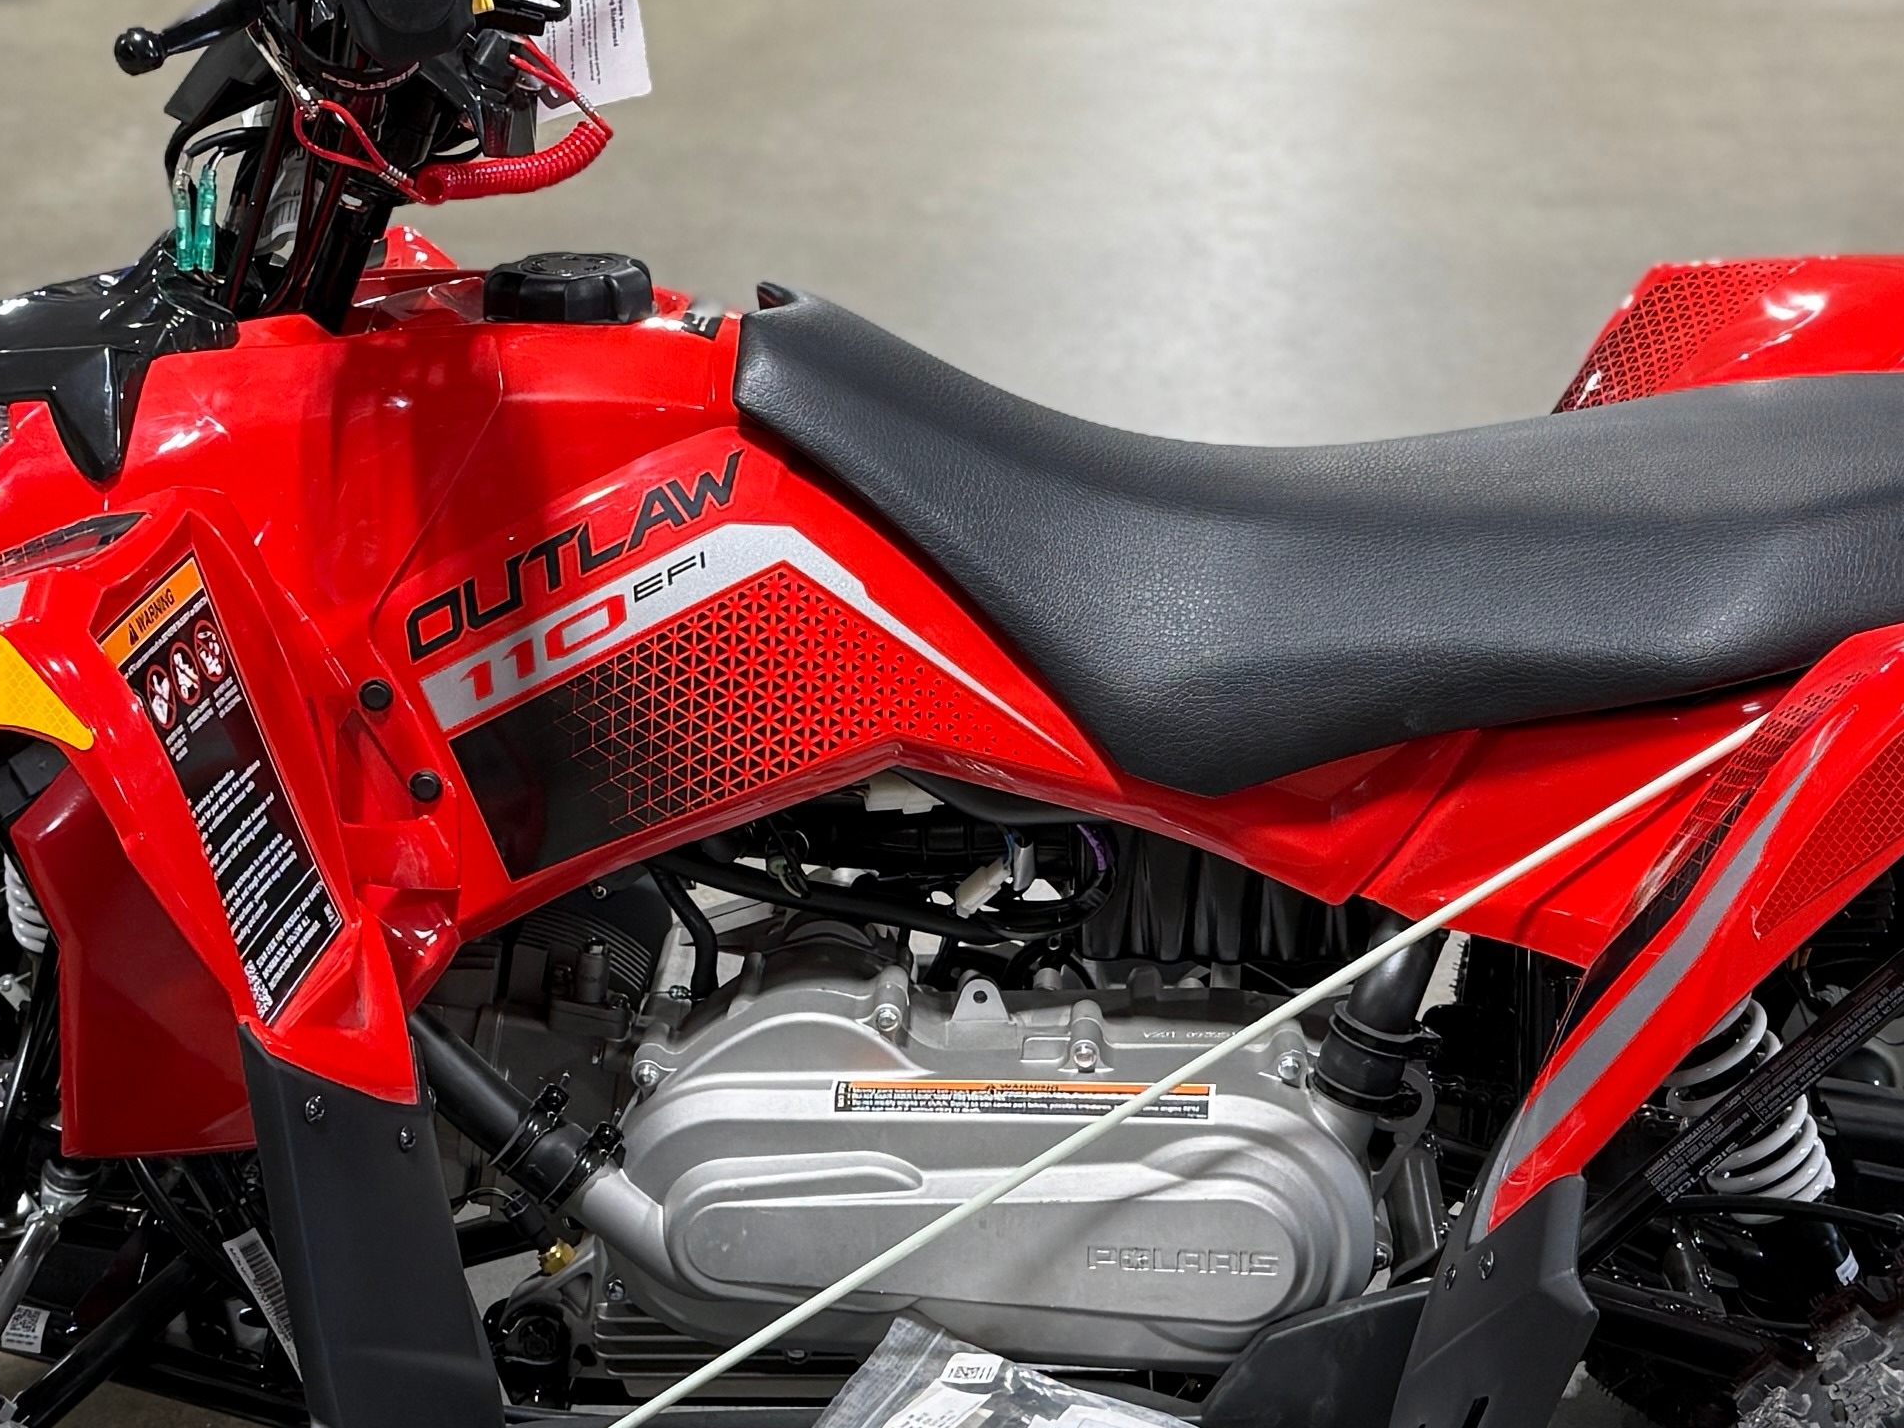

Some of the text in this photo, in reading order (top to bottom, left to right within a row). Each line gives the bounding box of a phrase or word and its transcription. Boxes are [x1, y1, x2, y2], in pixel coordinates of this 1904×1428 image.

[406, 448, 745, 662] OUTLAW
[133, 585, 177, 629] WARNING
[458, 551, 706, 702] 110 EFI
[1662, 1140, 1741, 1204] POLARIS
[1087, 1245, 1280, 1277] POLARIS
